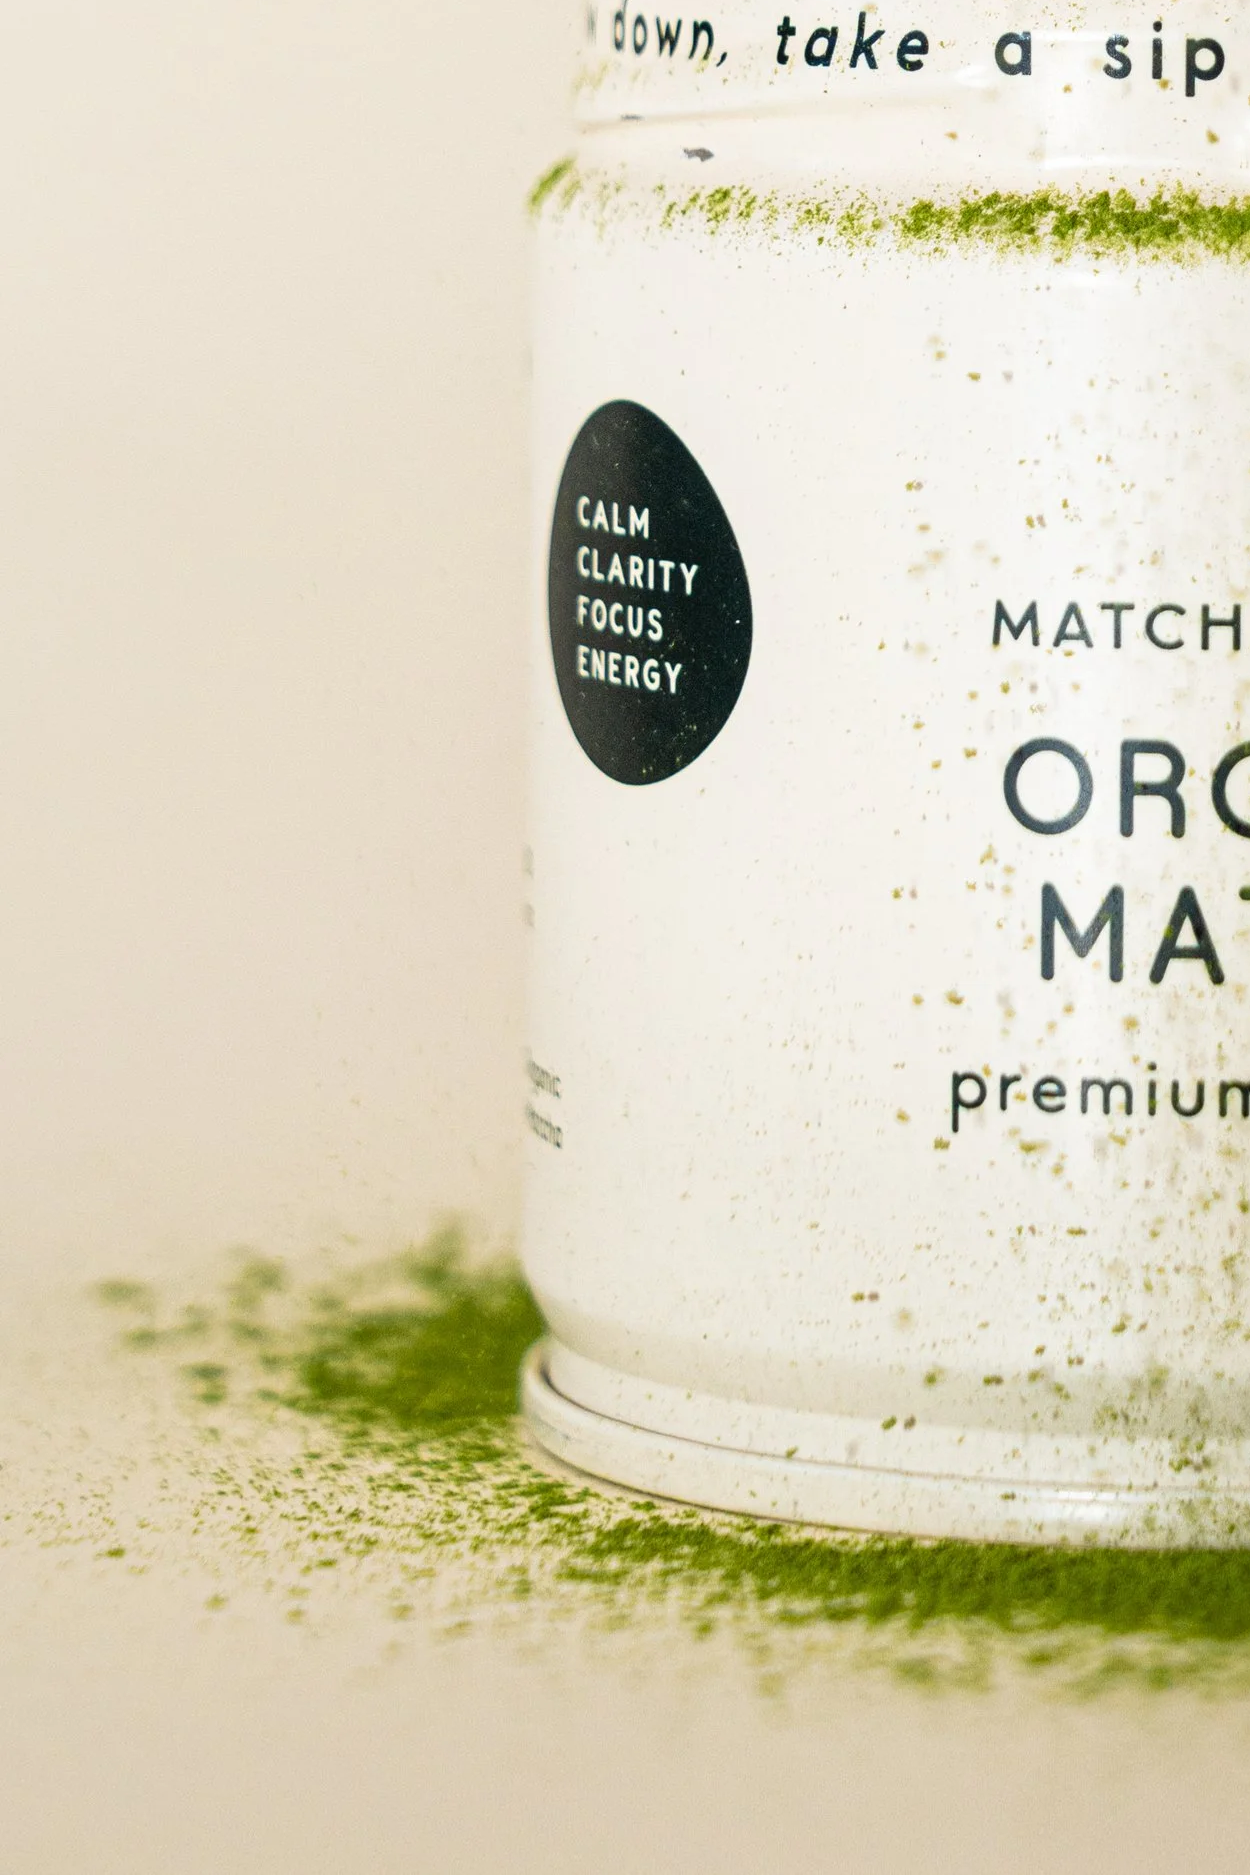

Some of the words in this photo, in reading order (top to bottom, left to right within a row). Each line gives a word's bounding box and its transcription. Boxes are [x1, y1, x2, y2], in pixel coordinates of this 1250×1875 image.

[776, 11, 930, 73] take
[994, 29, 1033, 77] a
[1102, 18, 1226, 98] sip
[576, 495, 650, 539] CALM
[576, 546, 699, 595] CLARITY
[576, 595, 663, 641] FOCUS
[576, 644, 682, 694] ENERGY
